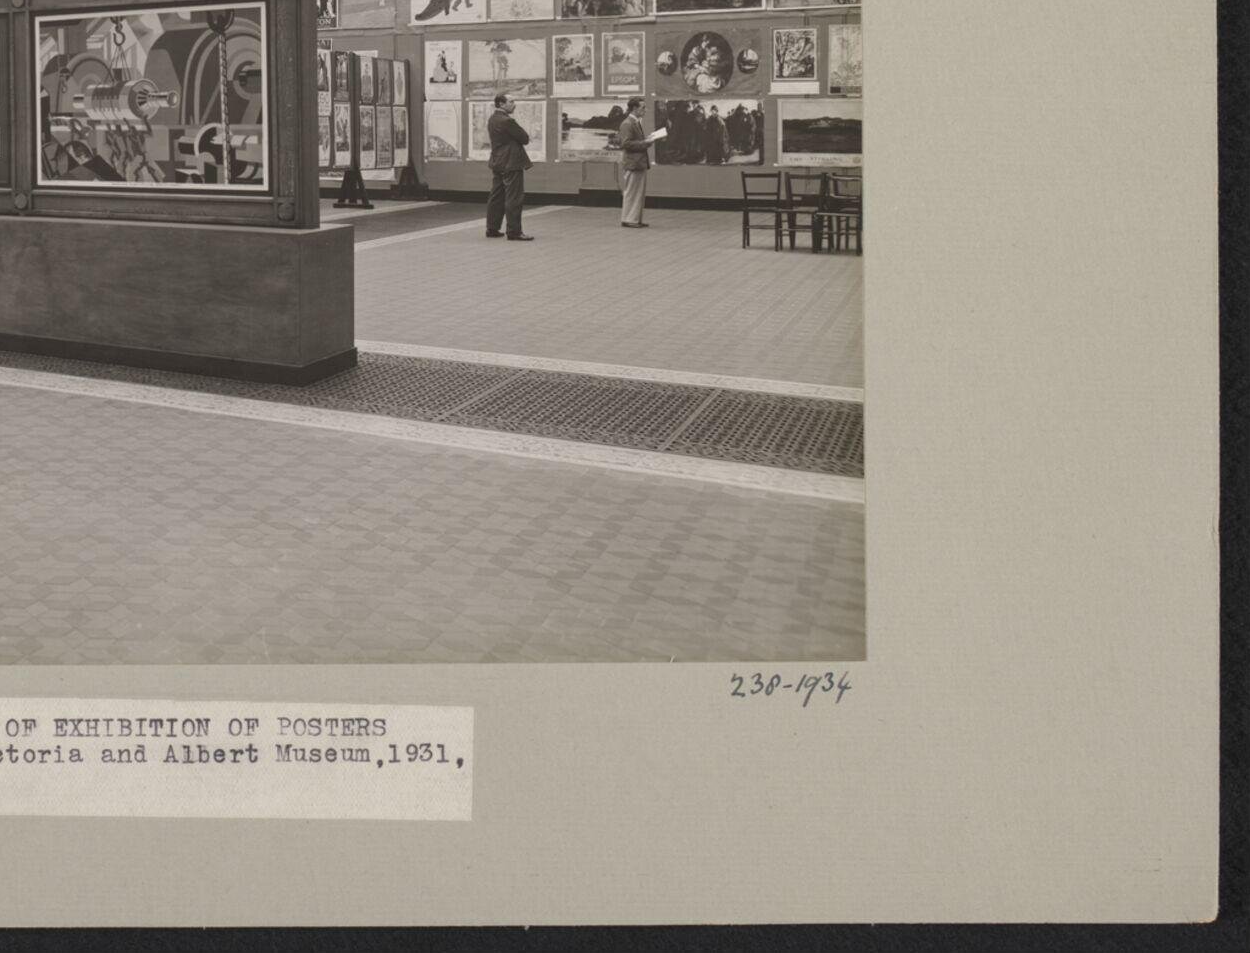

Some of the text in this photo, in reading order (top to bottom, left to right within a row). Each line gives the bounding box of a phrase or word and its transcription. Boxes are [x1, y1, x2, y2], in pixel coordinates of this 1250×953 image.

[730, 671, 852, 708] 238-1934
[5, 718, 37, 737] OF
[53, 717, 211, 738] EXHIBITION
[228, 717, 259, 736] OF
[277, 717, 386, 737] POSTERS
[101, 744, 147, 764] and
[163, 743, 259, 764] Albert
